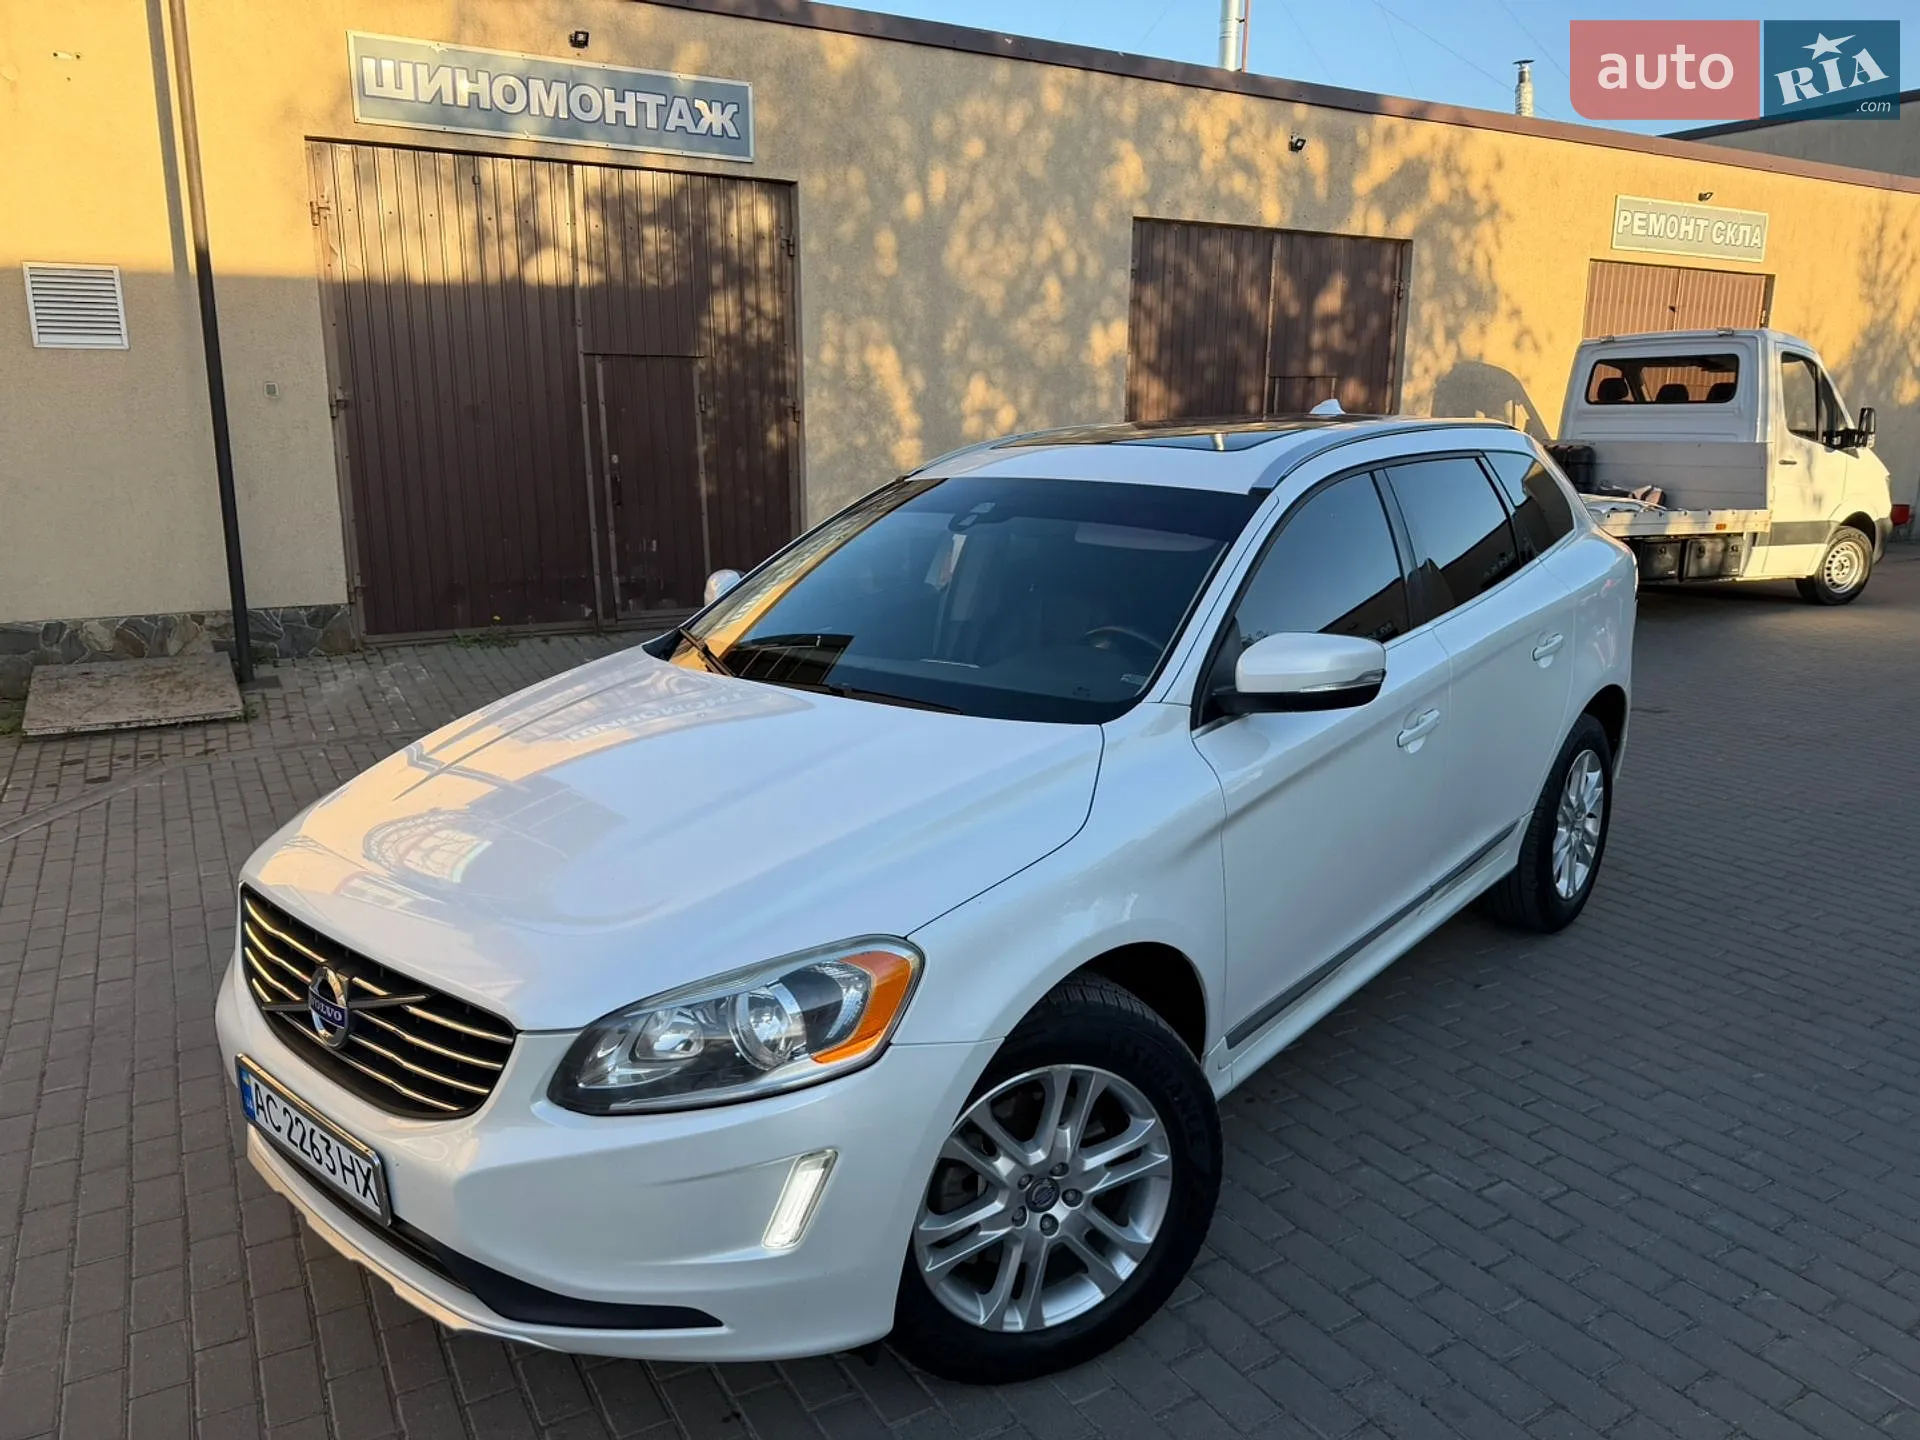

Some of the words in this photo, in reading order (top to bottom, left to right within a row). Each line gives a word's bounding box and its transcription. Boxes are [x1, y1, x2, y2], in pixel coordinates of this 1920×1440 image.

[361, 55, 740, 139] ШИНОМОНТАЖ
[1617, 209, 1710, 242] РЕМОНТ
[1712, 221, 1763, 248] СКЛА
